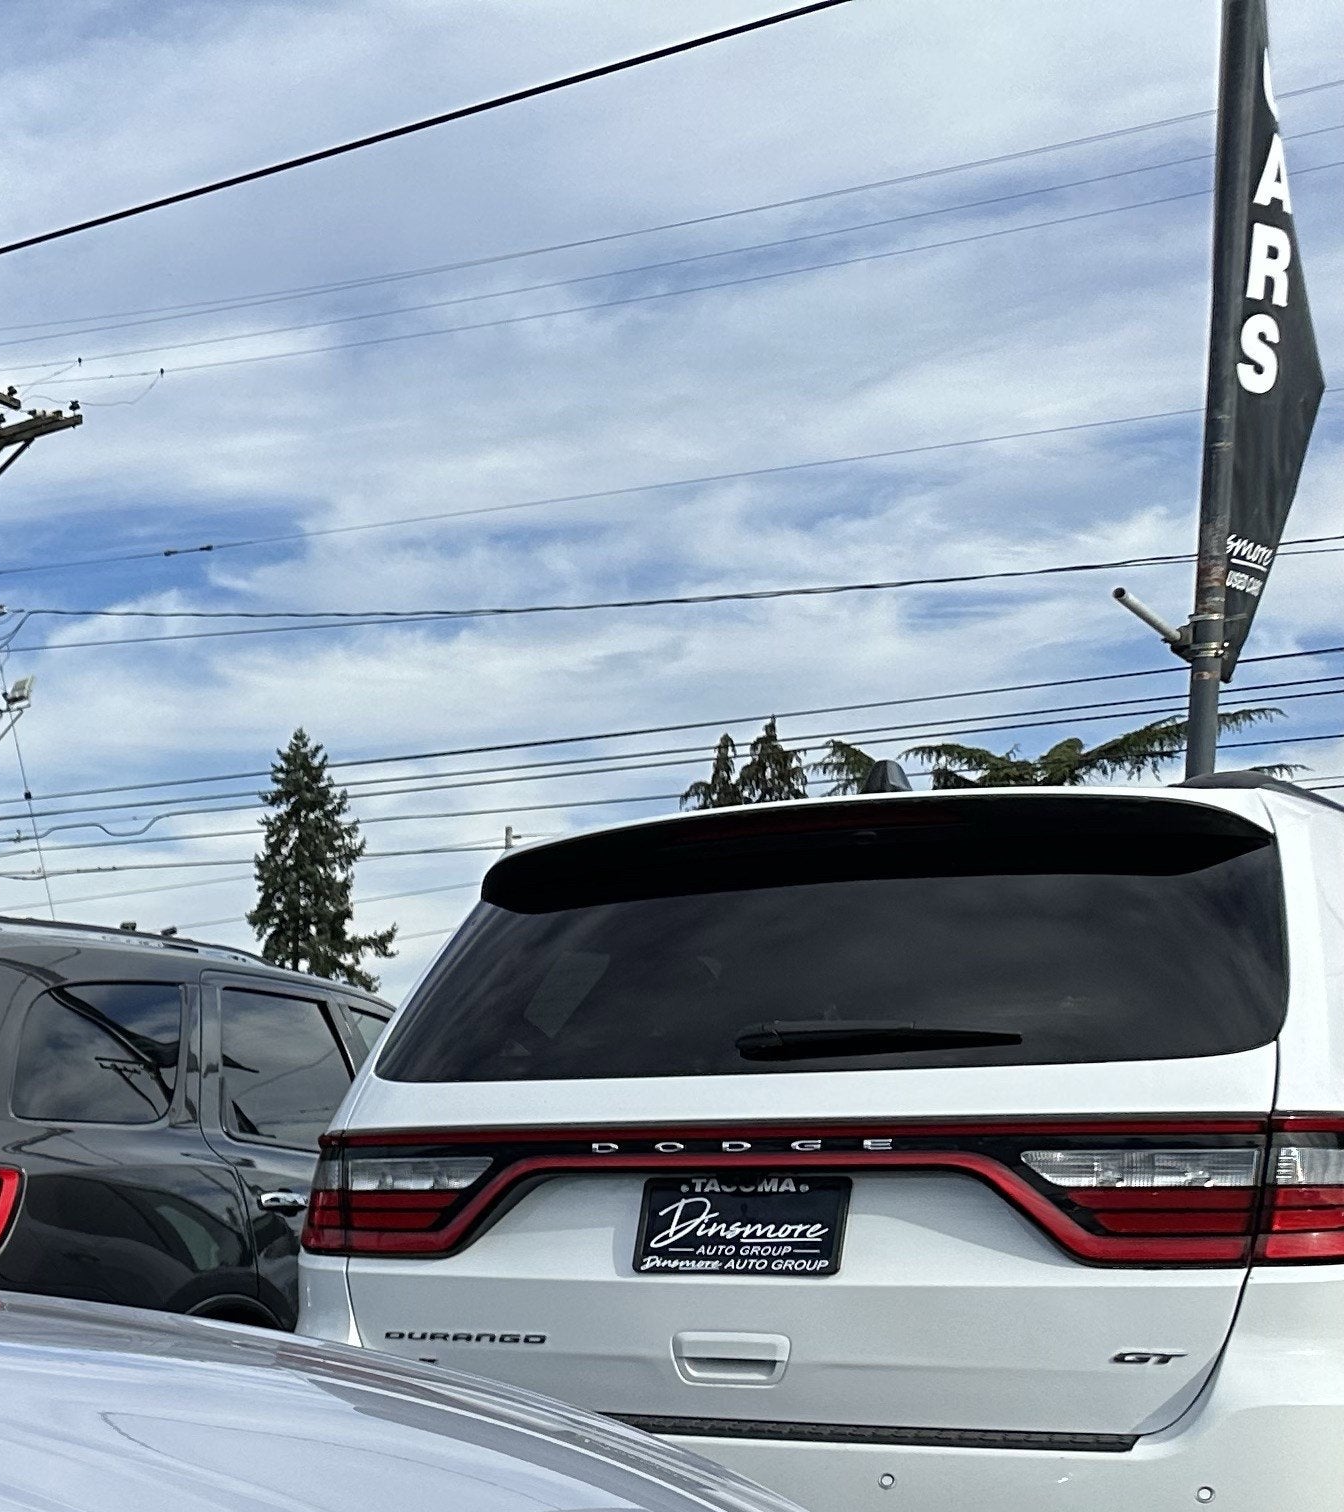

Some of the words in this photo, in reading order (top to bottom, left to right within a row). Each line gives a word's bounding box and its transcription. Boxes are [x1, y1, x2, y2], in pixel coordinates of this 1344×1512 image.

[591, 1138, 893, 1154] DODGE
[649, 1197, 829, 1248] Dinsmore
[695, 1245, 736, 1256] AUTO
[739, 1245, 792, 1256] GROUP
[724, 1258, 767, 1270] AUTO
[771, 1259, 829, 1271] GROUP
[384, 1331, 547, 1344] DURANGO
[1111, 1352, 1188, 1365] GT
